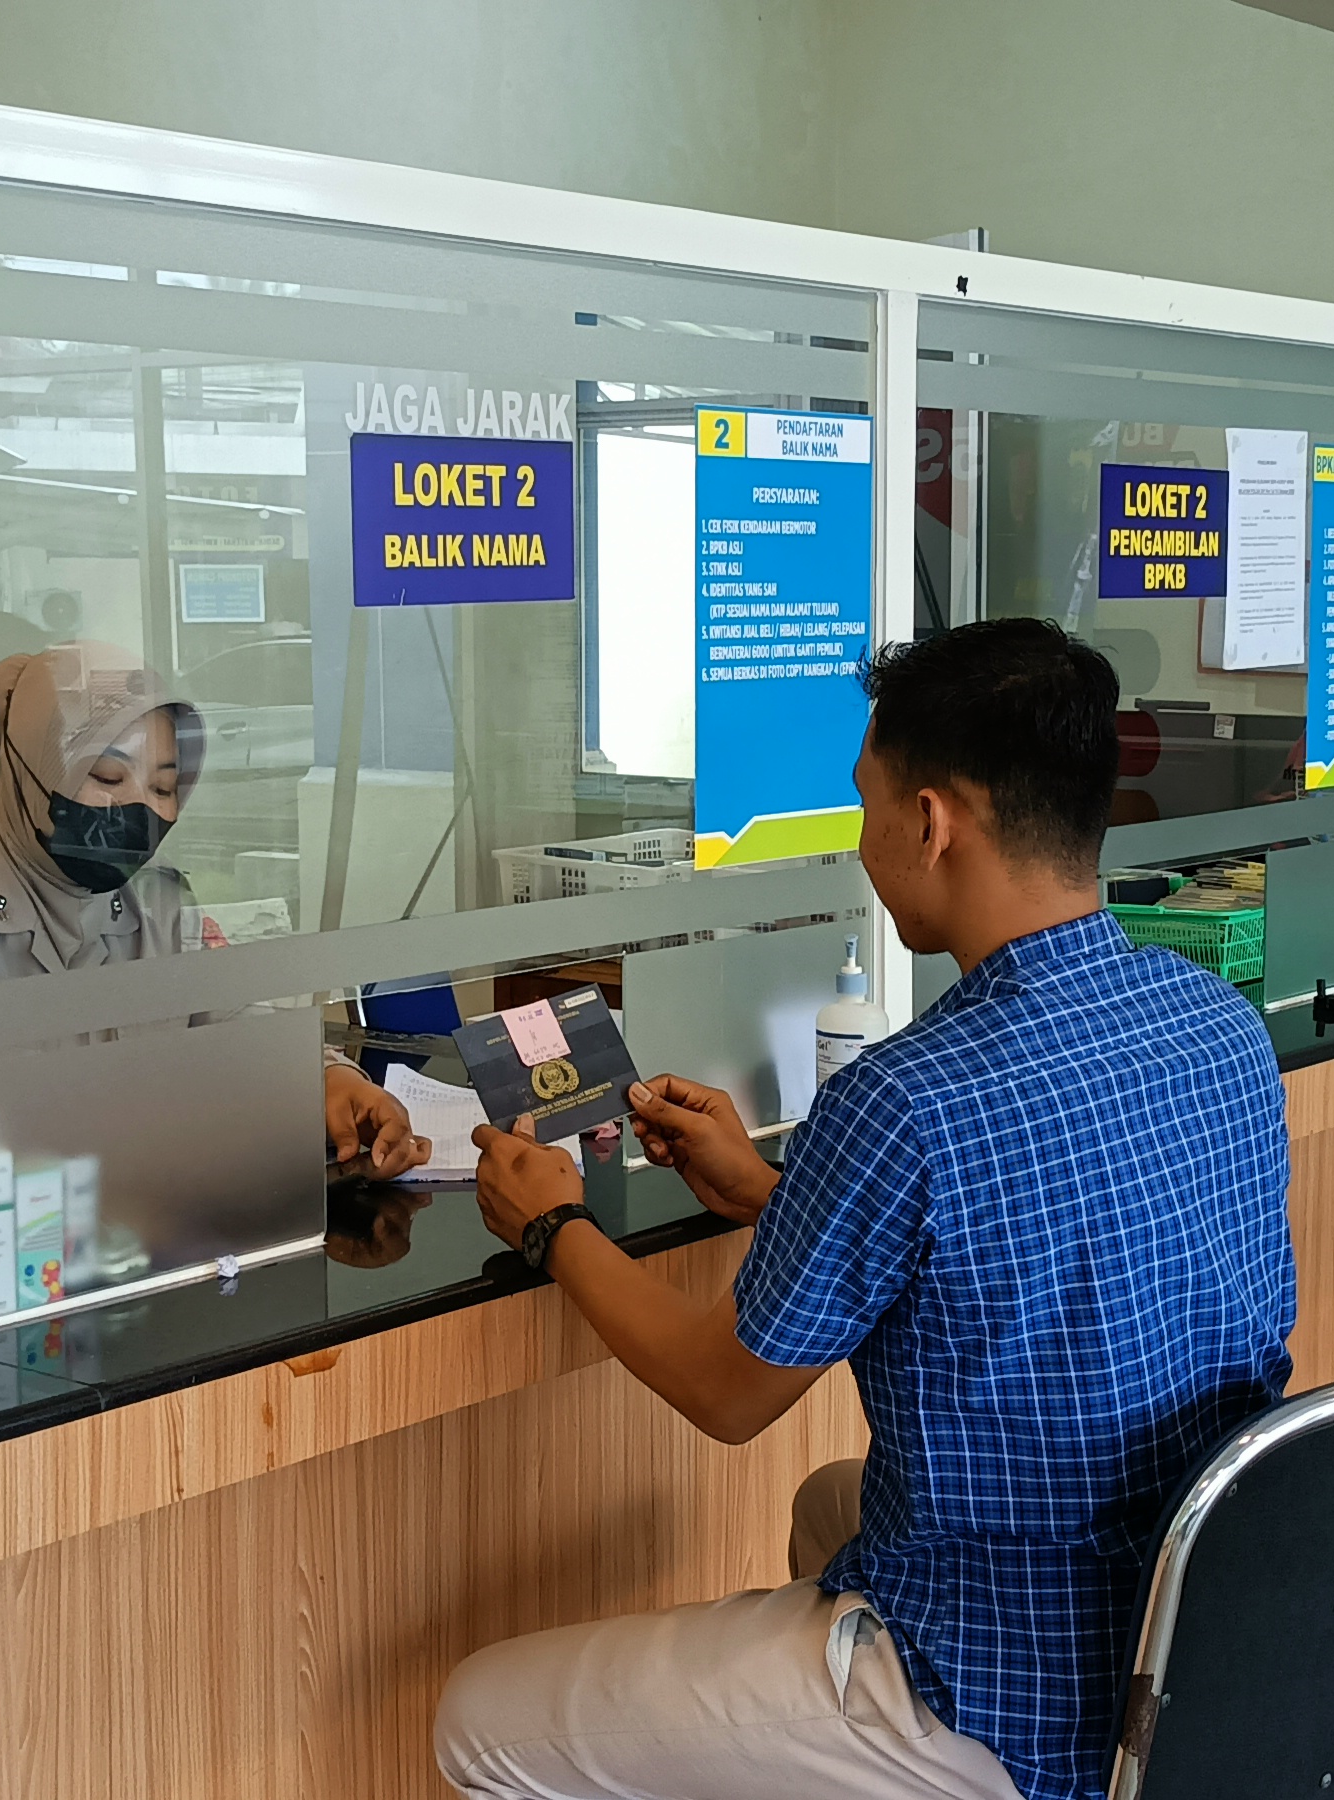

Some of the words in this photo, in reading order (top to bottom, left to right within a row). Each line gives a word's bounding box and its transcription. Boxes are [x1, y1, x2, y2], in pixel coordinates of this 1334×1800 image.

[345, 382, 445, 434] JAGA
[456, 389, 572, 439] JARAK
[714, 418, 729, 449] 2
[777, 419, 843, 438] PENDAFTARAN
[782, 440, 809, 456] BALIK
[811, 442, 838, 458] NAMA
[394, 462, 507, 507] LOKET
[517, 465, 535, 507] 2
[752, 487, 820, 504] PERSYARATAN:
[1124, 482, 1191, 518] LOKET
[1194, 485, 1207, 519] 2
[384, 534, 465, 568] BALIK
[472, 534, 546, 567] NAMA
[1109, 529, 1219, 557] PENGAMBILAN
[1144, 563, 1186, 590] BPKB
